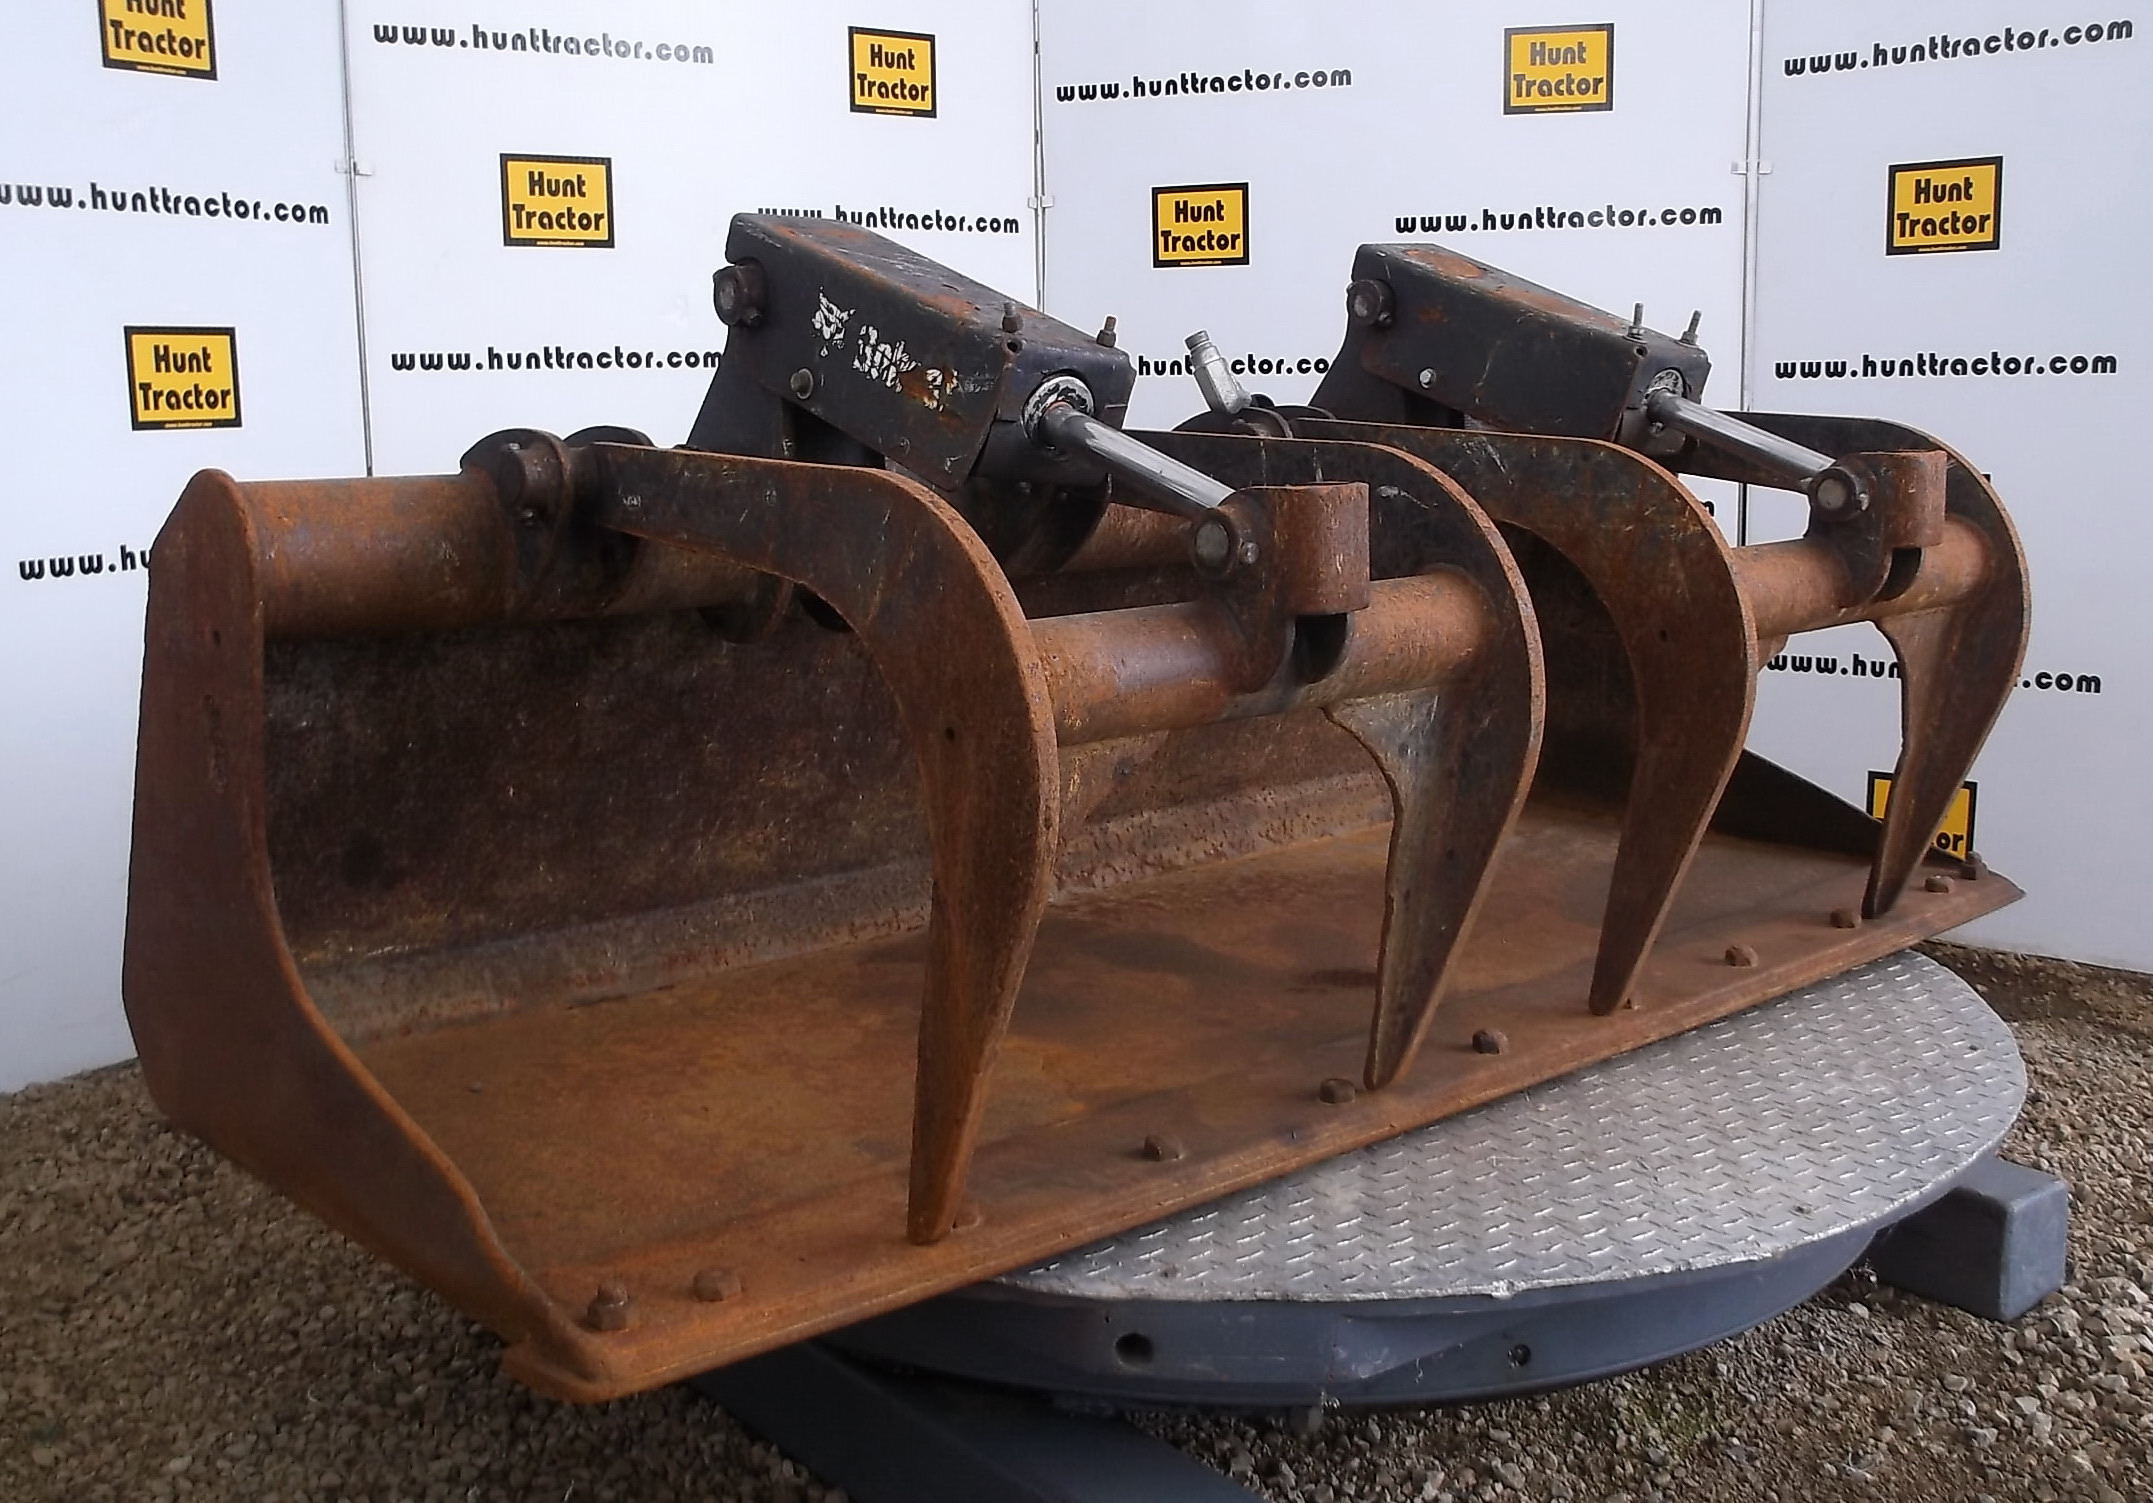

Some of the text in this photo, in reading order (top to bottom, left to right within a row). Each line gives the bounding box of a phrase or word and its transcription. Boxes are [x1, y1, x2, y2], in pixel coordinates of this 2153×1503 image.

[109, 19, 206, 59] Tractor
[373, 24, 713, 63] www.hunttractor.com
[1528, 40, 1588, 66] Hunt
[1784, 19, 2133, 77] www.hunttractor.com
[870, 43, 915, 71] Hunt
[856, 73, 930, 102] Tractor
[1056, 69, 1353, 103] www.hunttractor.com
[1512, 74, 1605, 98] Tractor
[528, 170, 586, 198] Hunt
[1914, 176, 1974, 205] Hunt
[512, 203, 605, 232] Tractor
[757, 204, 1019, 234] hunttractor.com
[1174, 199, 1225, 224] Hunt
[1395, 204, 1722, 234] www.hunttractor.com
[1896, 210, 1991, 239] Tractor
[1160, 229, 1241, 254] Tractor
[153, 344, 212, 374] Hunt
[391, 345, 722, 371] www.hunttractor.com
[1775, 351, 2117, 380] www.hunttractor.com
[138, 382, 231, 412] Tractor
